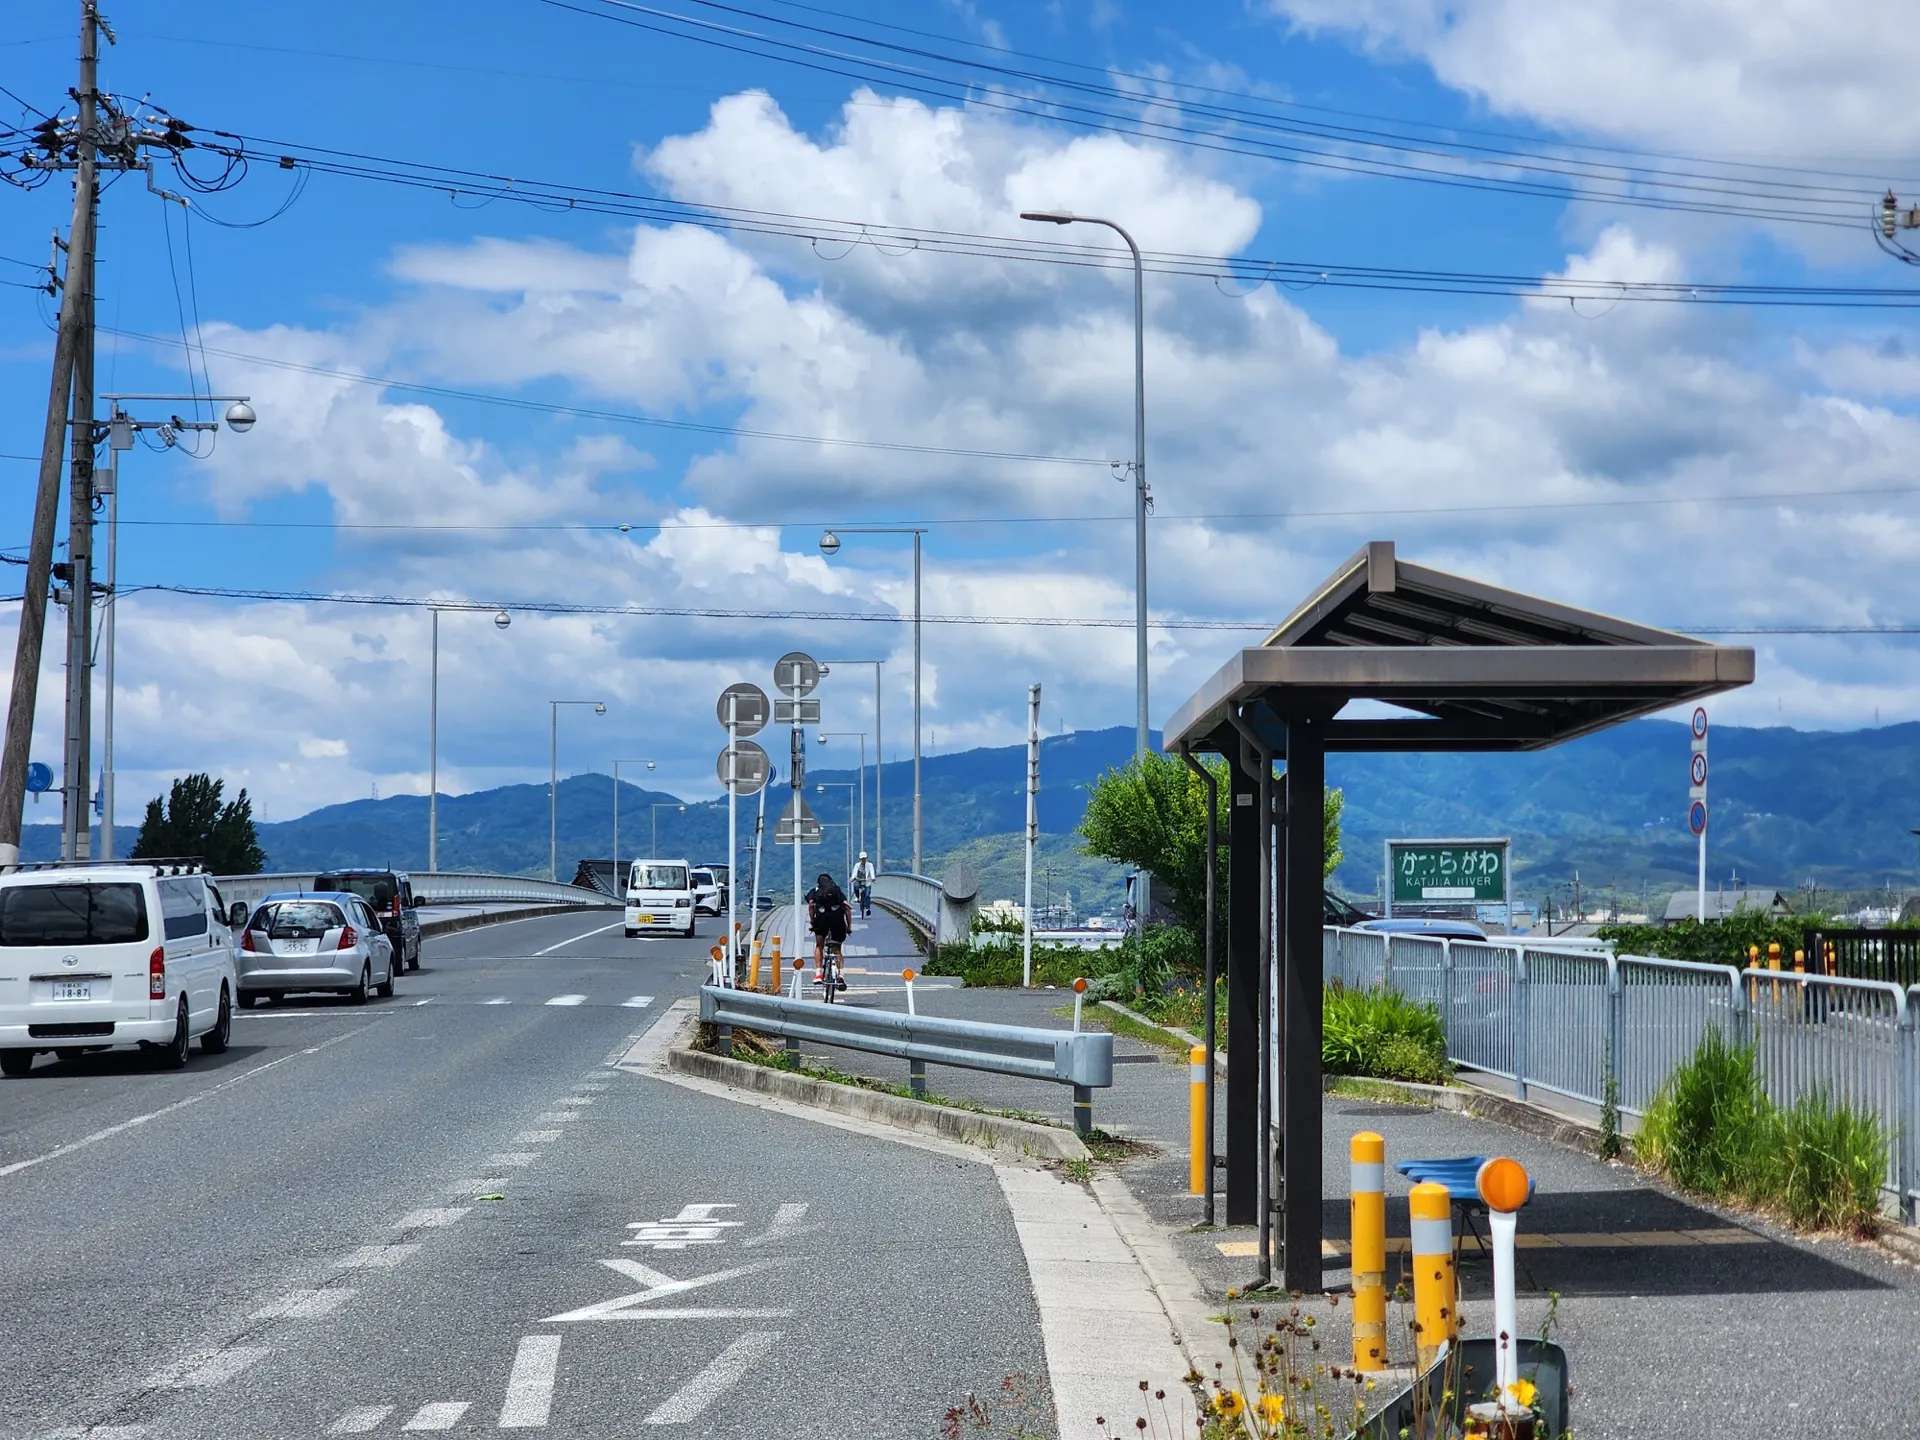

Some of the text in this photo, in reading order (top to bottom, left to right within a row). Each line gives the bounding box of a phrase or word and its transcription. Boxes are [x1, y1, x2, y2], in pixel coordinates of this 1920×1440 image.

[1400, 850, 1499, 875] かつらがわ
[62, 988, 88, 998] 18-87
